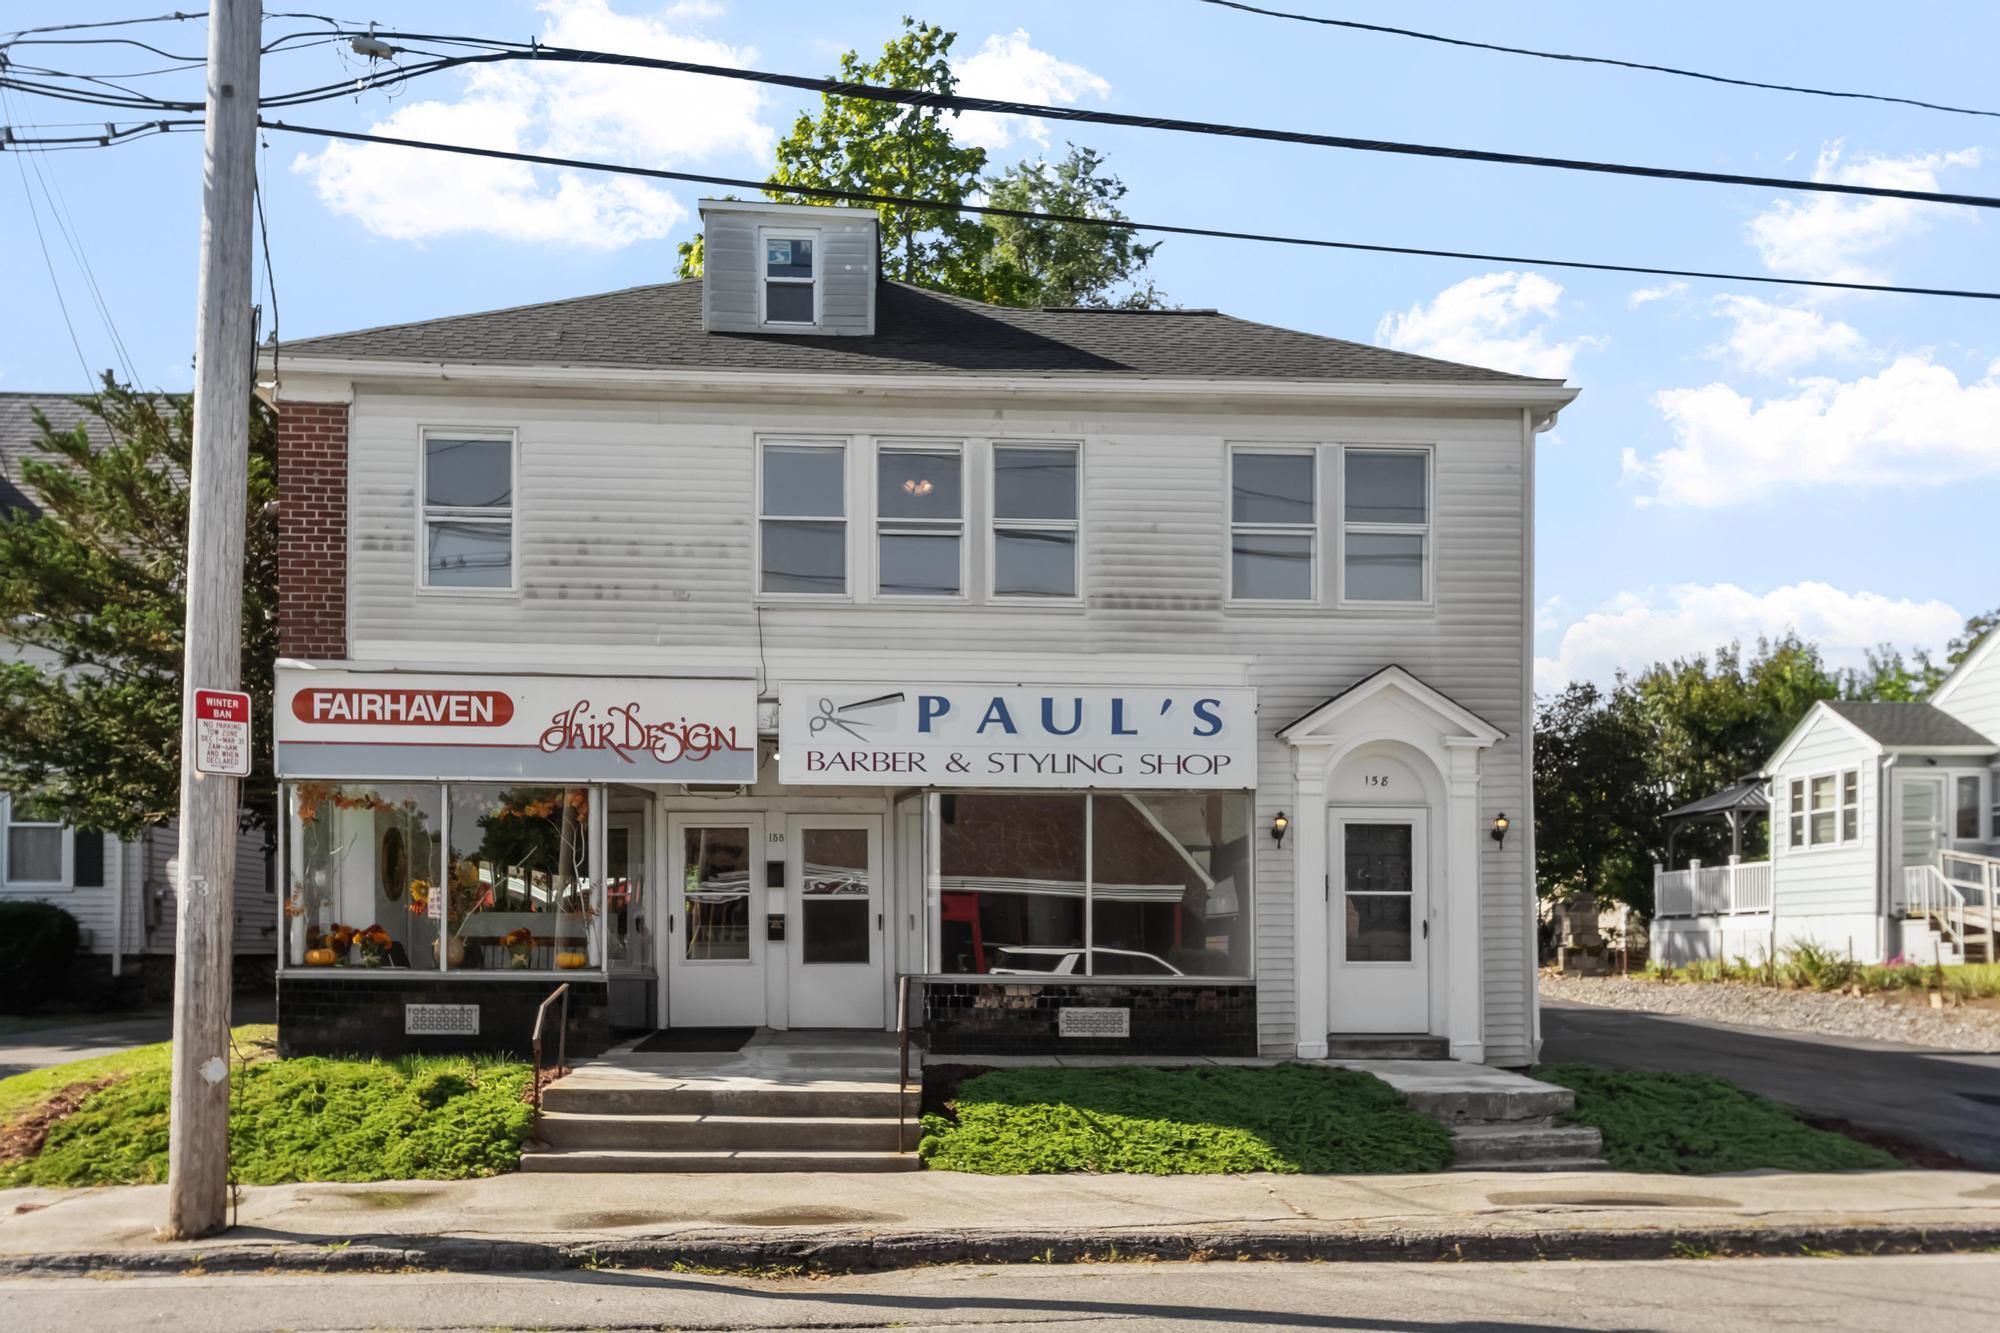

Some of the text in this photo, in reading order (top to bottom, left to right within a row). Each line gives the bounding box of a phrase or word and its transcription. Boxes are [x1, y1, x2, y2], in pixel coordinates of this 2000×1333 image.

[206, 698, 239, 708] WINTER
[312, 692, 494, 723] FAIRHAVEN
[213, 709, 232, 719] BAN
[917, 694, 1224, 737] PAUL'S
[203, 721, 242, 730] NO PARKING
[206, 757, 239, 765] DECLARED
[806, 750, 1231, 775] BARBER & STYLING SHOP
[1365, 775, 1388, 787] 158
